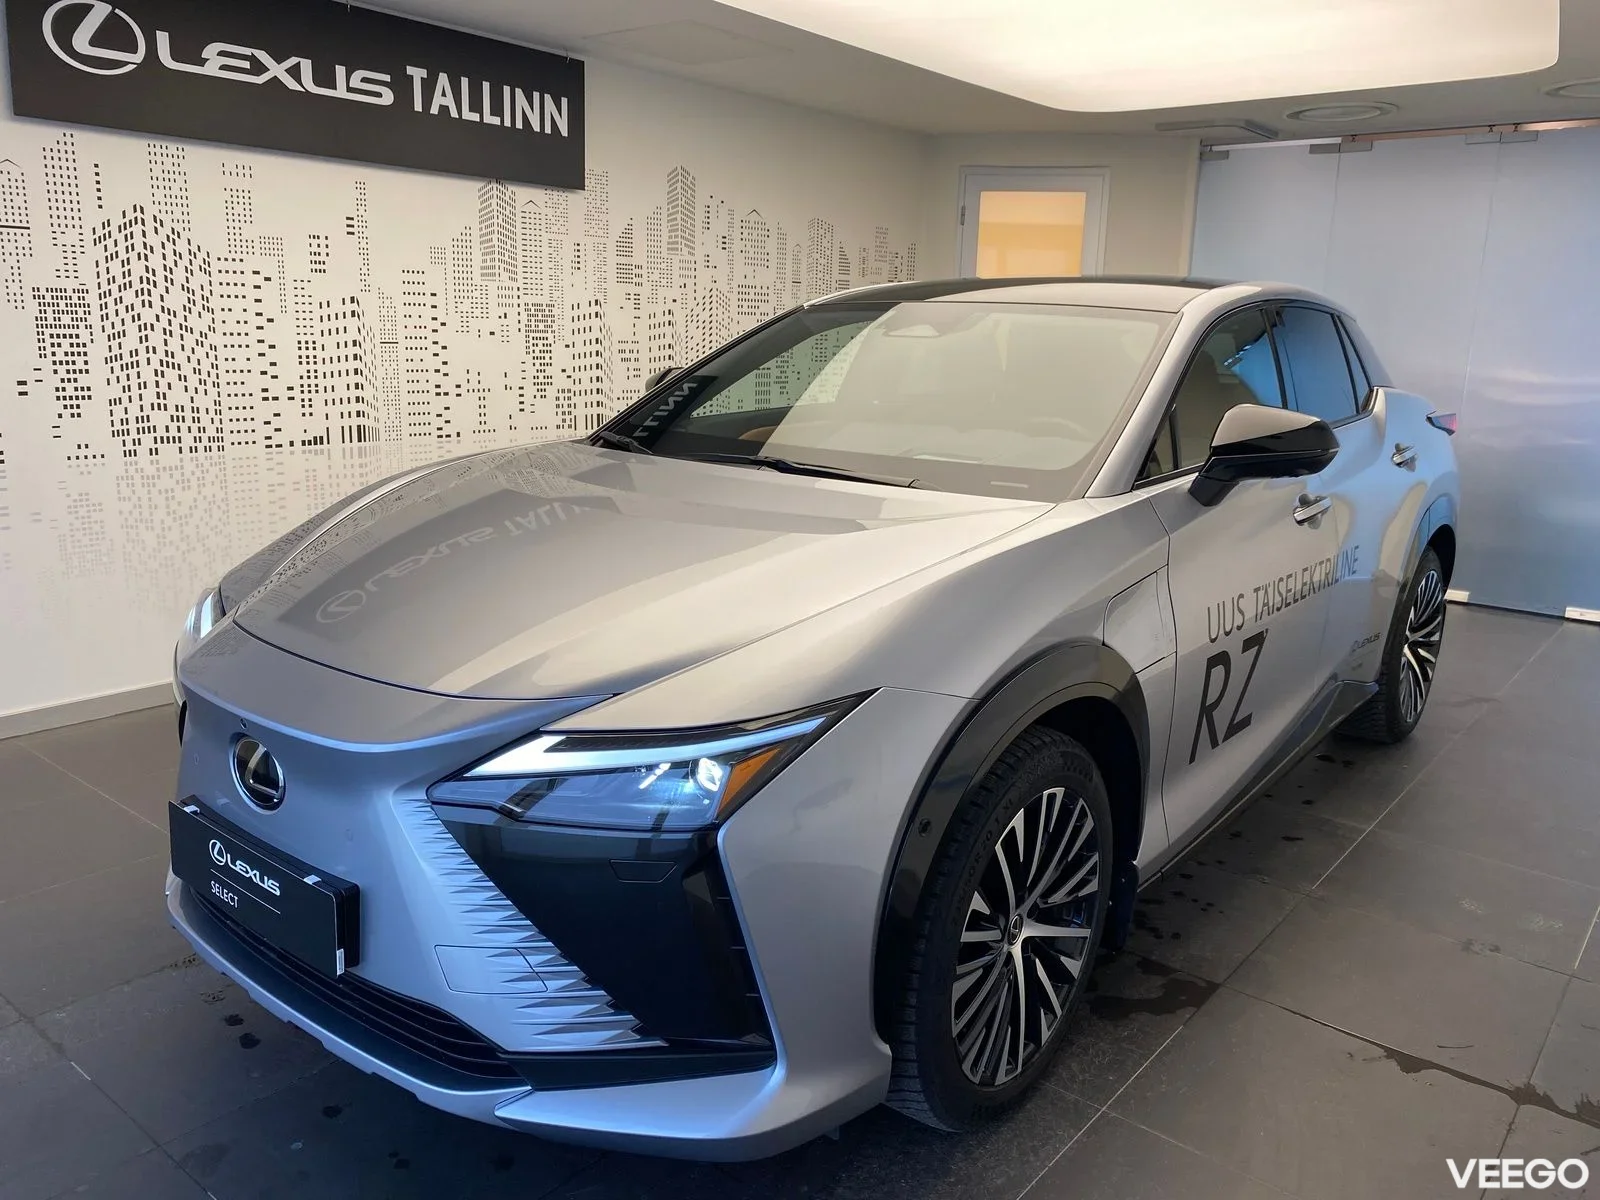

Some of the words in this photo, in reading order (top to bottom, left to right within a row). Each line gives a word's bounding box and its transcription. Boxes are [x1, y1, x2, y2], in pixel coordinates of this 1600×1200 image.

[156, 30, 395, 106] LEXUS
[406, 65, 569, 137] TALLINN
[1207, 593, 1245, 643] UUS
[1253, 545, 1360, 623] TÄISELEKTRILINE
[1189, 628, 1269, 765] RZ
[210, 880, 239, 908] SELECT
[227, 853, 281, 896] LEXUS
